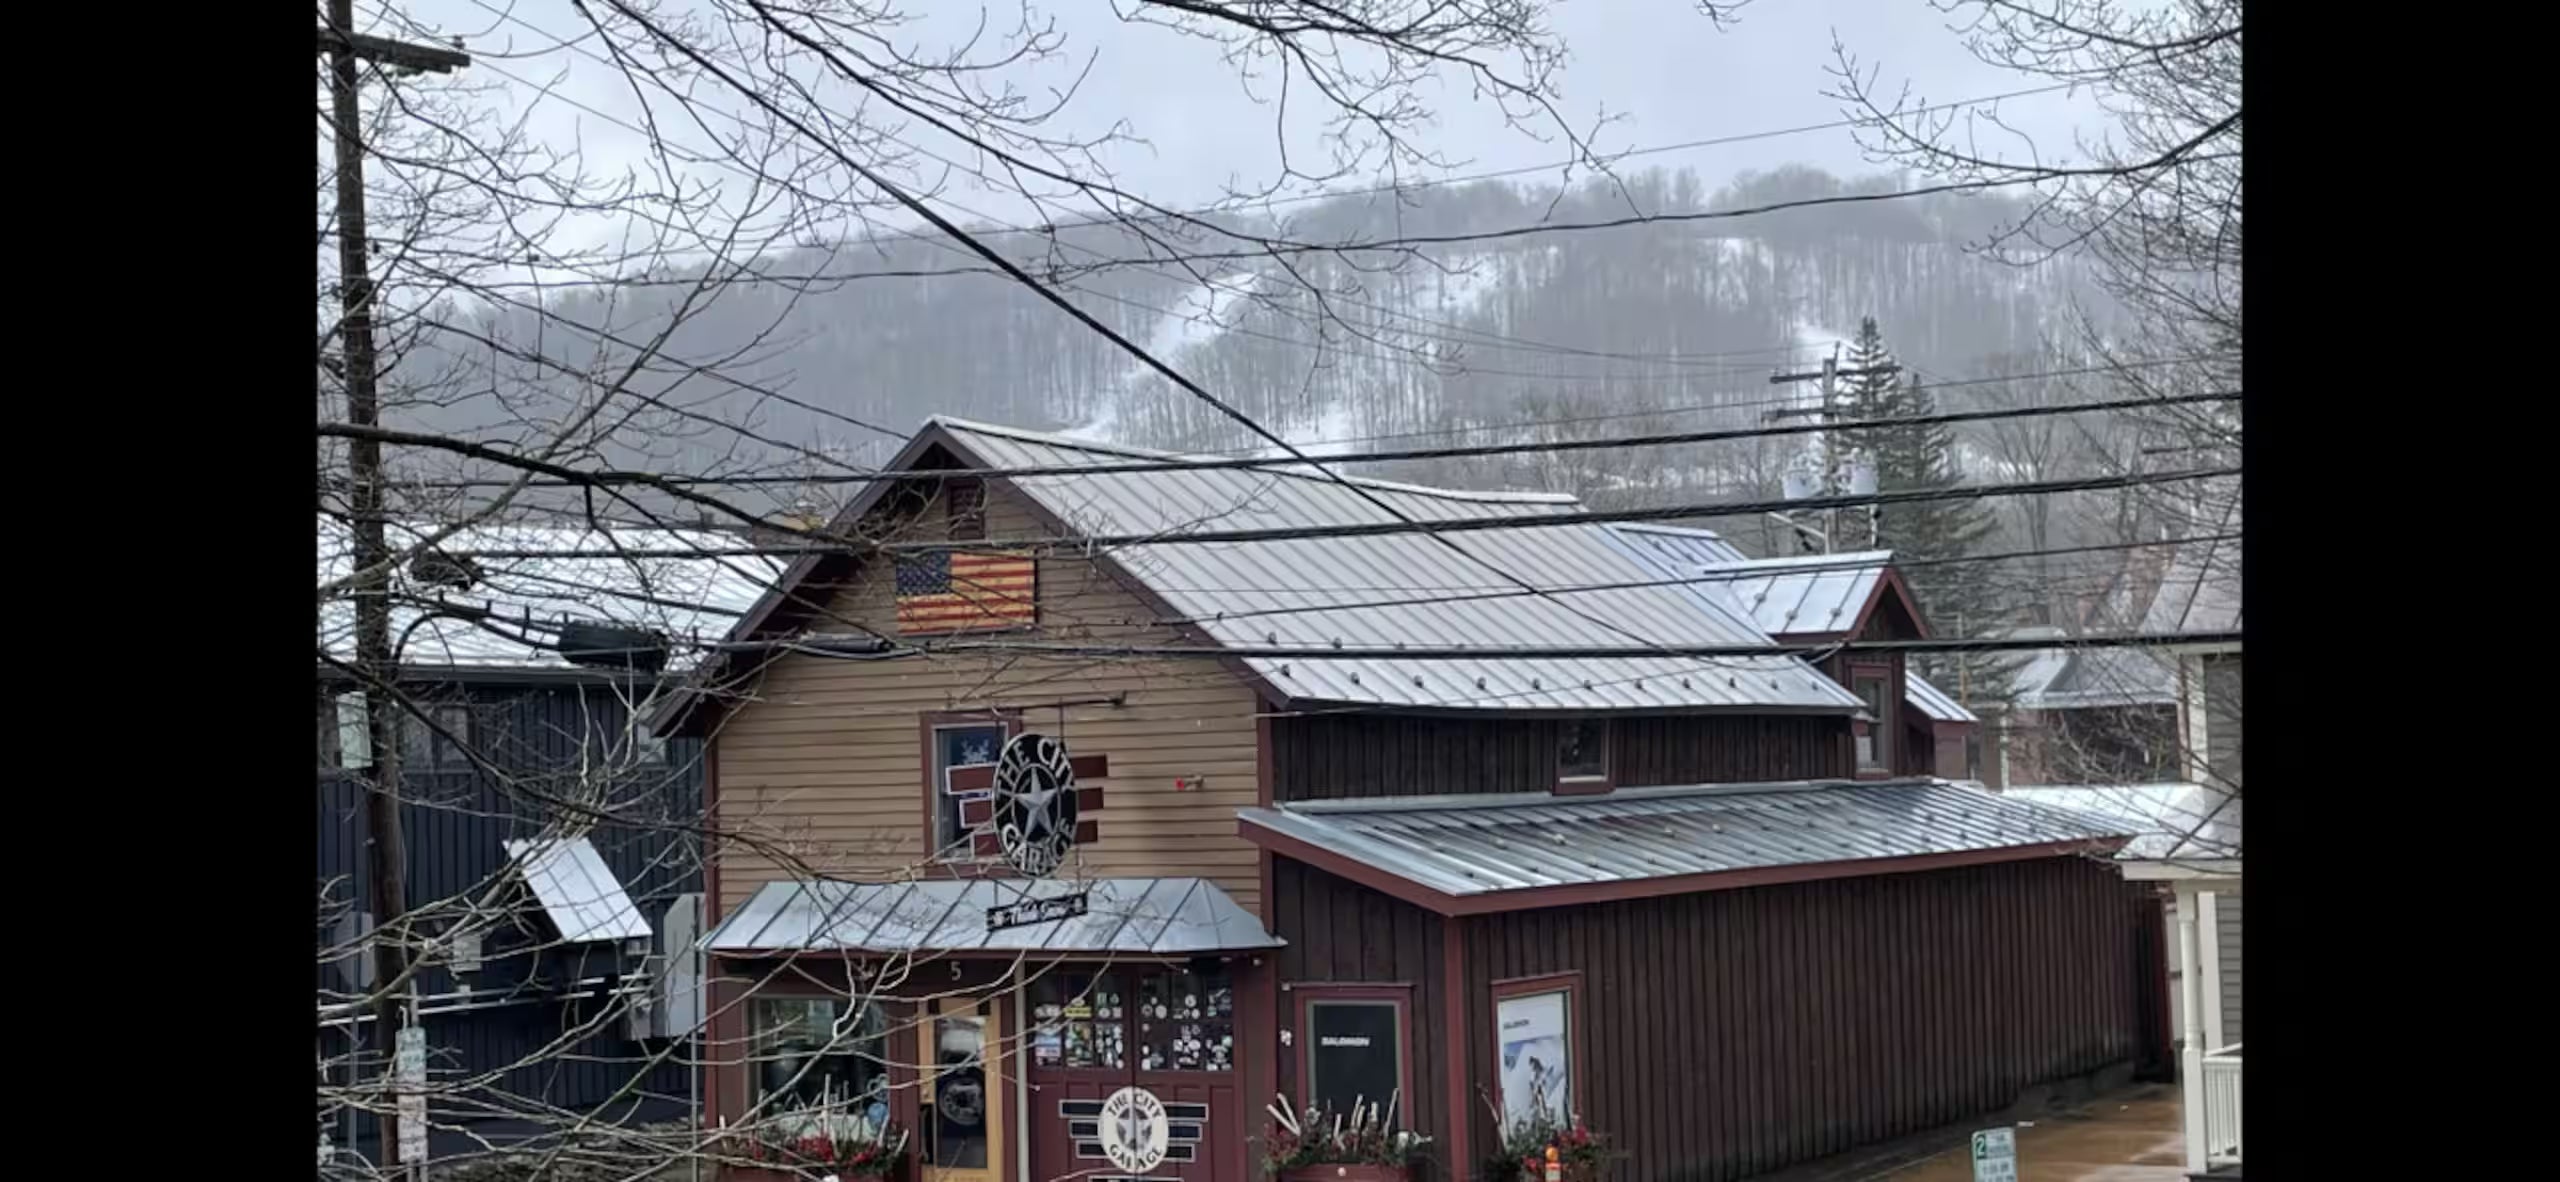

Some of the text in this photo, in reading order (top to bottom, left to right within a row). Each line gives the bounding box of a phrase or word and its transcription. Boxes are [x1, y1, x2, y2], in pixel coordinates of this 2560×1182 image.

[997, 737, 1075, 799] THE CITY
[1002, 817, 1074, 876] GARAGE
[951, 961, 962, 981] 5
[1321, 1036, 1370, 1047] SALOMON
[1107, 1093, 1161, 1118] THE CITY
[1109, 1143, 1162, 1169] GARAGE
[1977, 1135, 1985, 1157] 2
